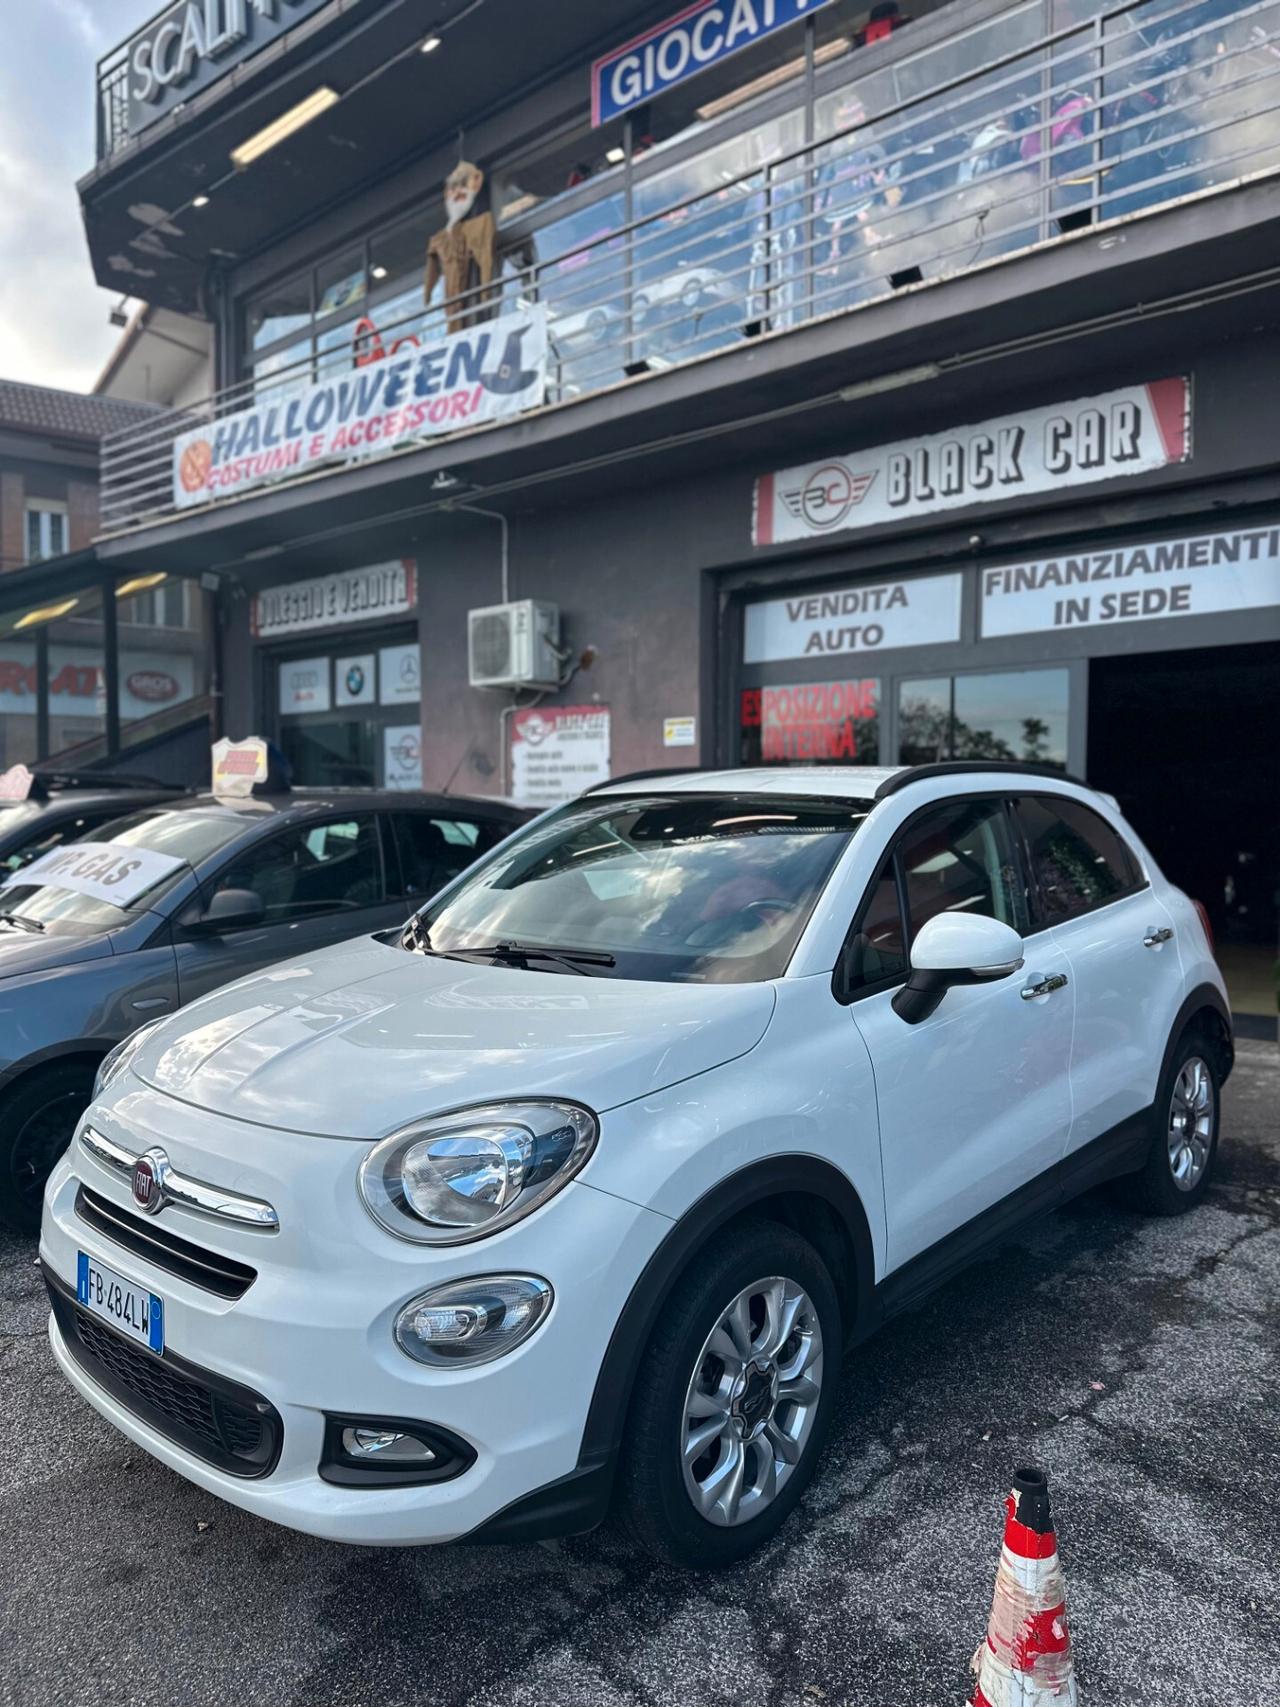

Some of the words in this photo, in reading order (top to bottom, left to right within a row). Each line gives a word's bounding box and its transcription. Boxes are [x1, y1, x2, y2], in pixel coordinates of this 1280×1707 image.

[211, 333, 491, 465] HALLOWEEN
[205, 442, 300, 490] COSTUMI
[308, 442, 325, 458] E
[330, 384, 484, 453] ACCESSORI
[887, 426, 1025, 507] BLACK
[1044, 401, 1141, 474] CAR
[984, 529, 1279, 597] FINANZIAMENTI
[786, 586, 909, 623] VENDITA
[1054, 597, 1091, 625] IN
[1099, 584, 1193, 619] SEDE
[804, 623, 884, 654] AUTO
[742, 679, 877, 726] ESPOSIZIONE
[762, 719, 858, 761] INTERNA
[71, 853, 143, 886] GAS
[135, 1170, 152, 1198] FIAT
